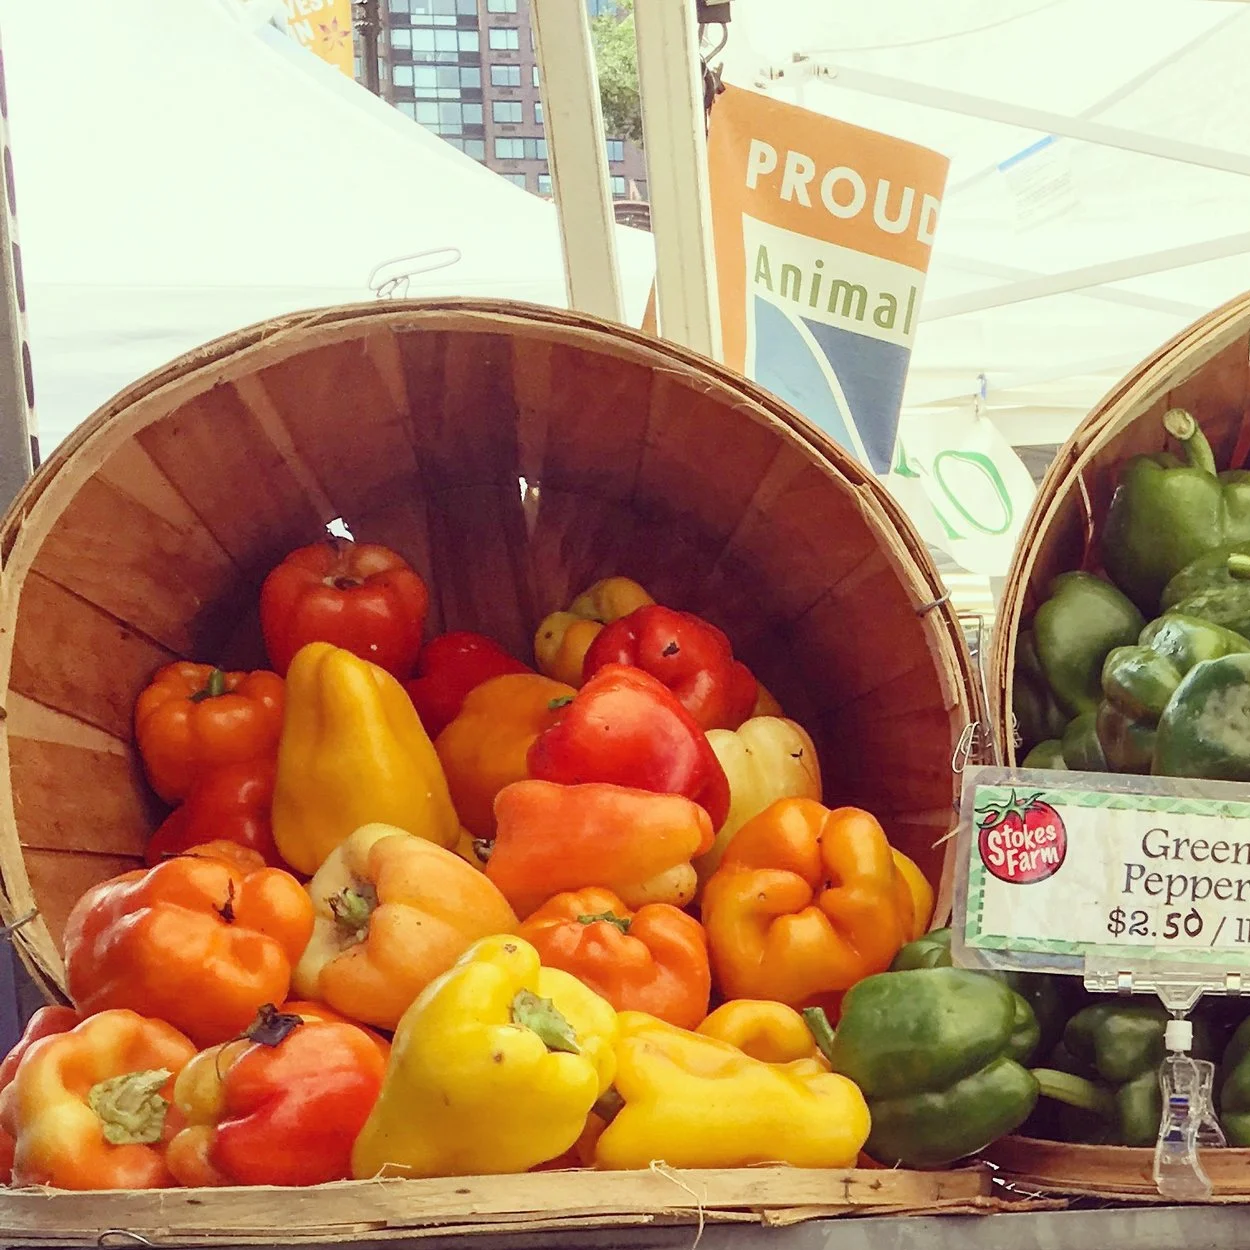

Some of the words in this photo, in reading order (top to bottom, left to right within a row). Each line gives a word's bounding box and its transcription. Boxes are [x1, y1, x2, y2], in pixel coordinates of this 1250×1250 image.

[745, 138, 942, 246] PROUD
[753, 244, 918, 336] Animal
[987, 823, 1057, 867] Stokes
[1006, 846, 1060, 877] Farm
[1107, 906, 1204, 940] $2.50
